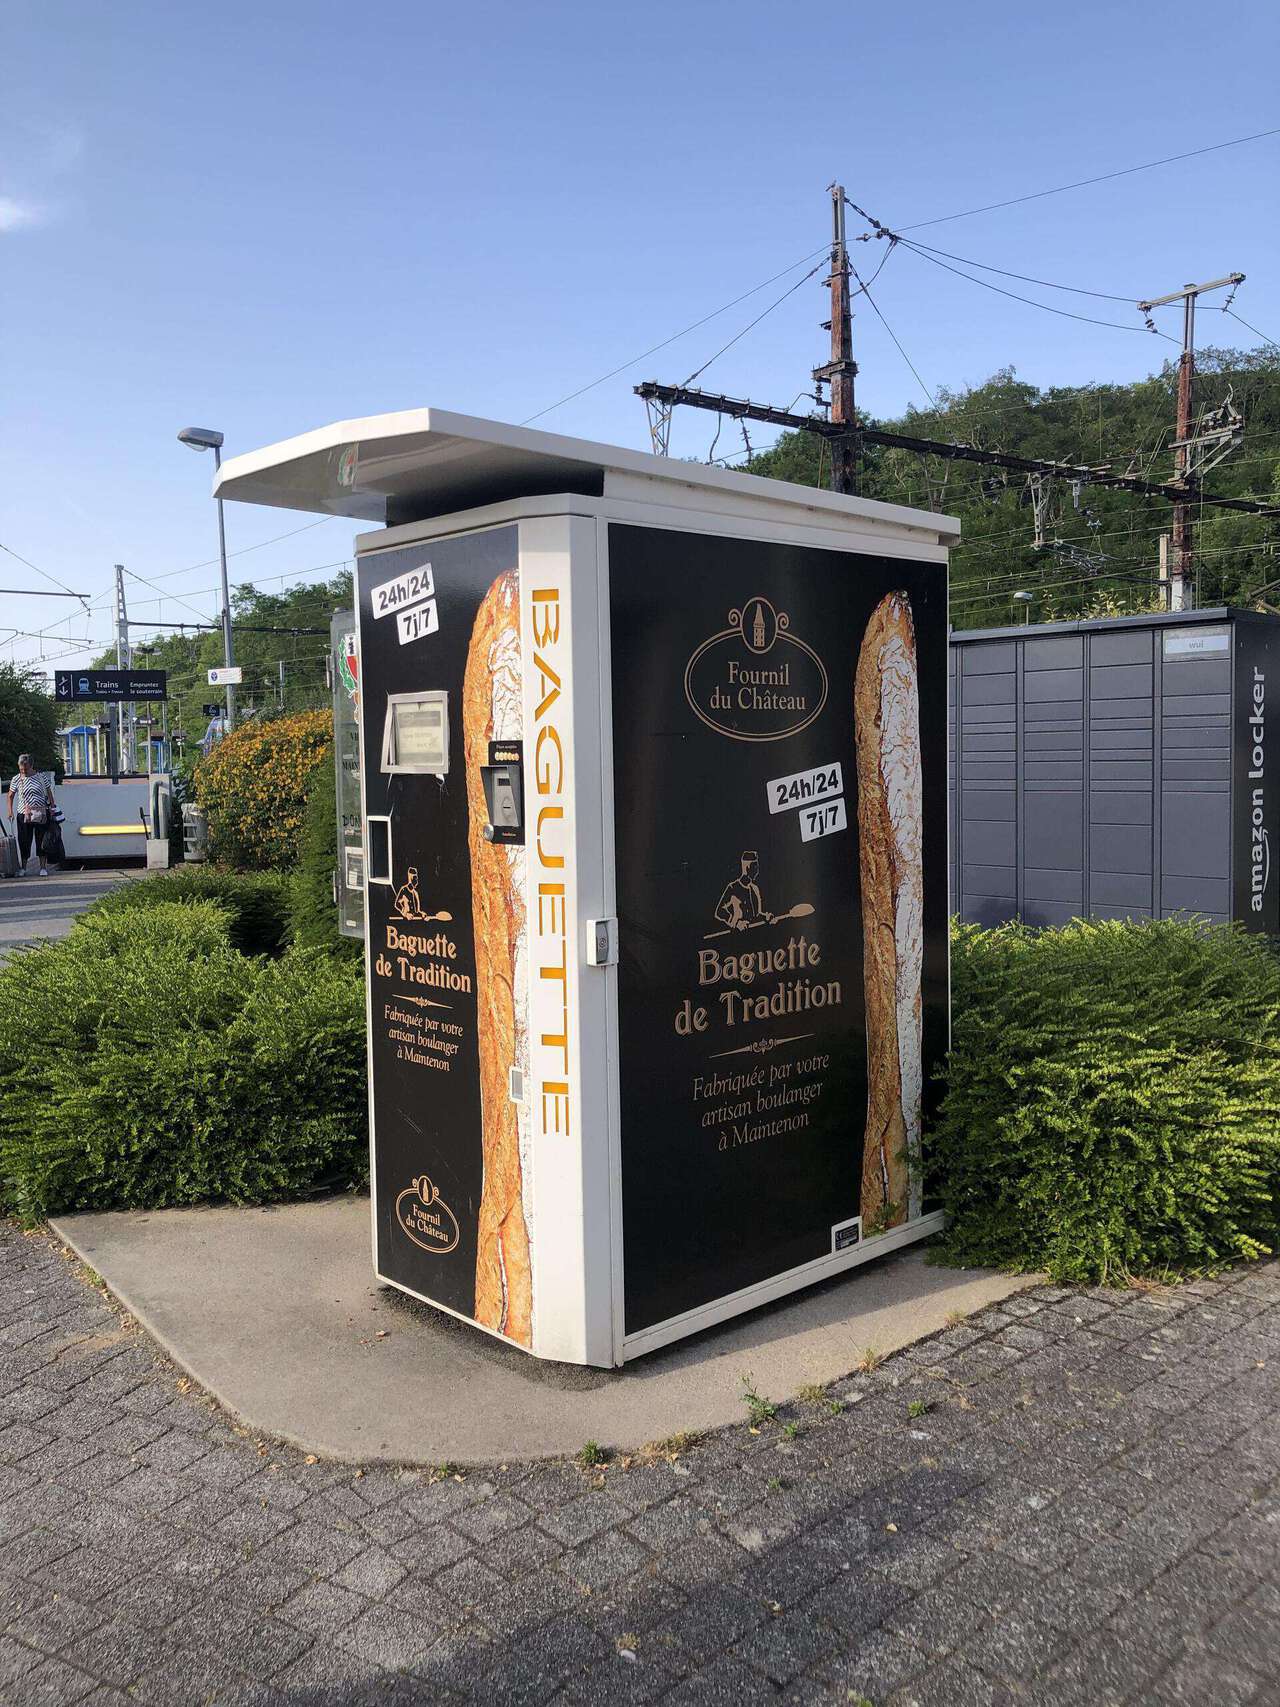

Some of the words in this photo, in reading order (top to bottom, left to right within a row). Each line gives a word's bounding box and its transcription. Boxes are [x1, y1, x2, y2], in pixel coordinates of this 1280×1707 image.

[378, 571, 430, 610] 24h/24
[403, 608, 431, 638] 7j/7
[95, 680, 119, 689] Trains
[728, 661, 790, 686] Fournil
[710, 686, 732, 709] du
[738, 687, 807, 710] Château
[1248, 666, 1266, 779] locker
[776, 769, 839, 805] 24h/24
[807, 806, 839, 834] 7j/7
[531, 589, 570, 1137] BAGUETTE
[1249, 787, 1267, 913] amazon
[386, 925, 457, 959] Baguette
[375, 953, 393, 978] de
[397, 956, 472, 993] Tradition
[697, 936, 822, 985] Baguette
[384, 1004, 423, 1029] Fabriquée
[425, 1016, 440, 1032] par
[441, 1022, 464, 1037] votre
[674, 999, 709, 1036] de
[719, 978, 842, 1026] Tradition
[388, 1028, 416, 1044] artisan
[417, 1031, 460, 1056] boulanger
[397, 1045, 403, 1058] à
[405, 1046, 450, 1072] Maintenon
[692, 1064, 765, 1101] Fabriquée
[769, 1063, 793, 1087] par
[796, 1053, 831, 1073] votre
[701, 1098, 753, 1128] artisan
[757, 1081, 823, 1111] boulanger
[718, 1131, 728, 1152] à
[732, 1111, 810, 1147] Maintenon
[405, 1214, 416, 1229] du
[417, 1219, 449, 1243] Château
[412, 1203, 441, 1226] Fournil
